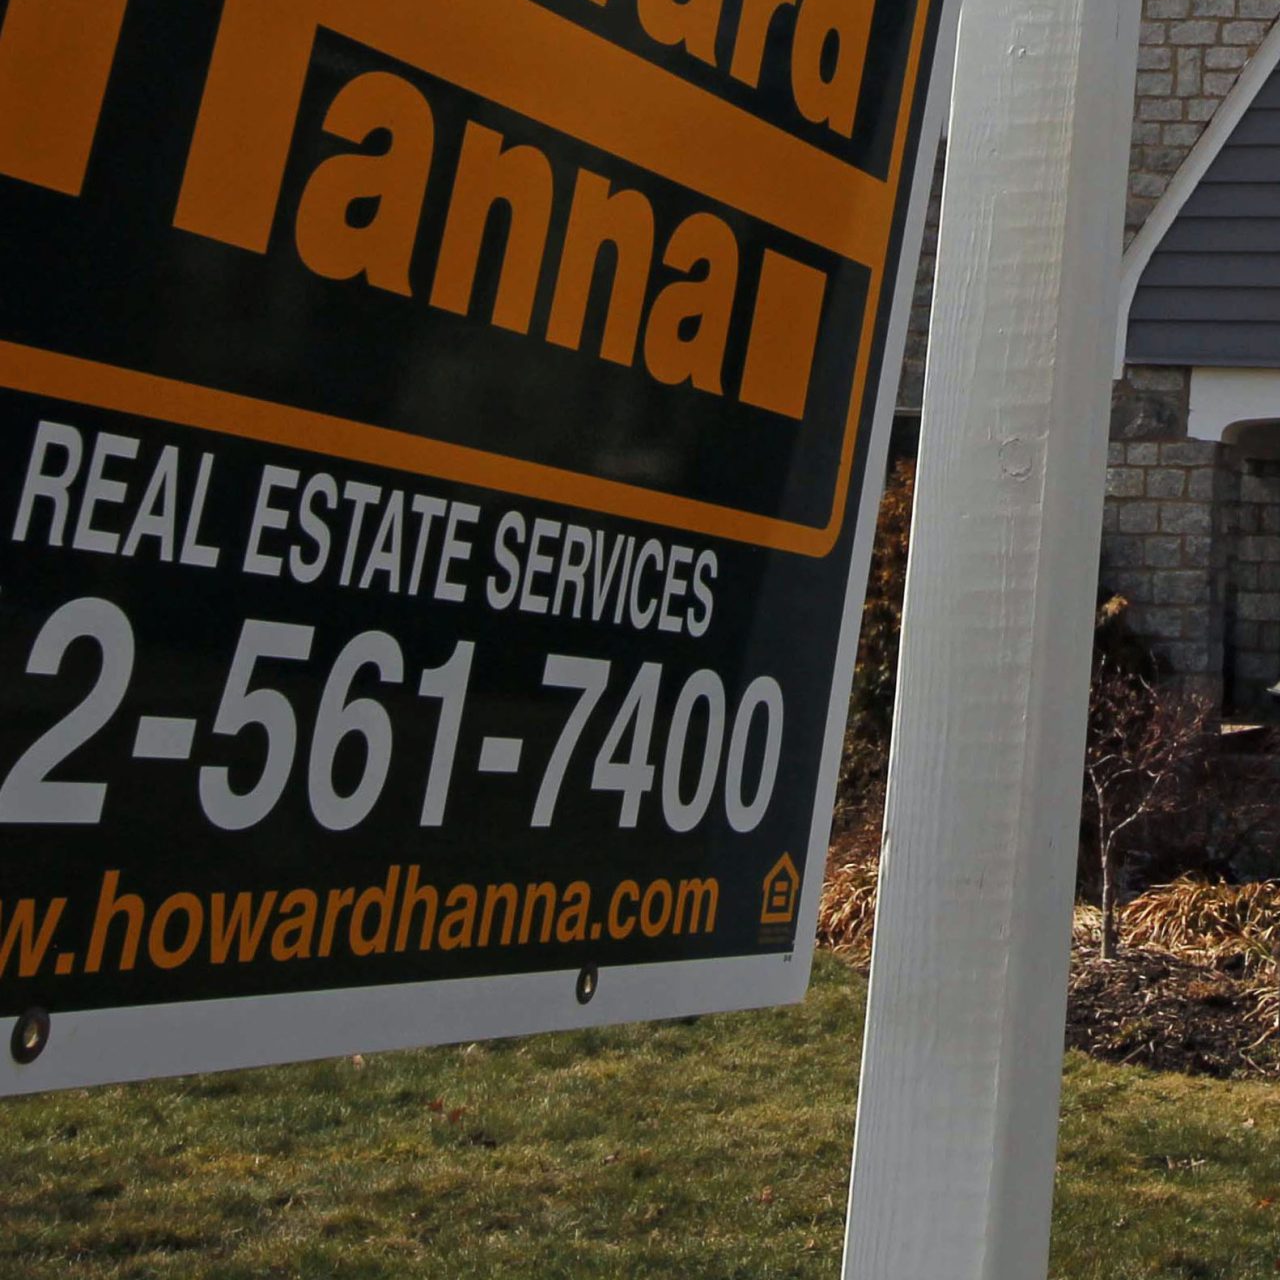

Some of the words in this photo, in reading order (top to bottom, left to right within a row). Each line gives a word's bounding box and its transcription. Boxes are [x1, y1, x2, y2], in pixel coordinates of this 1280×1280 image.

[12, 420, 221, 568] REAL
[243, 464, 481, 603] ESTATE
[487, 510, 718, 638] SERVICES
[0, 596, 785, 834] 2-561-7400
